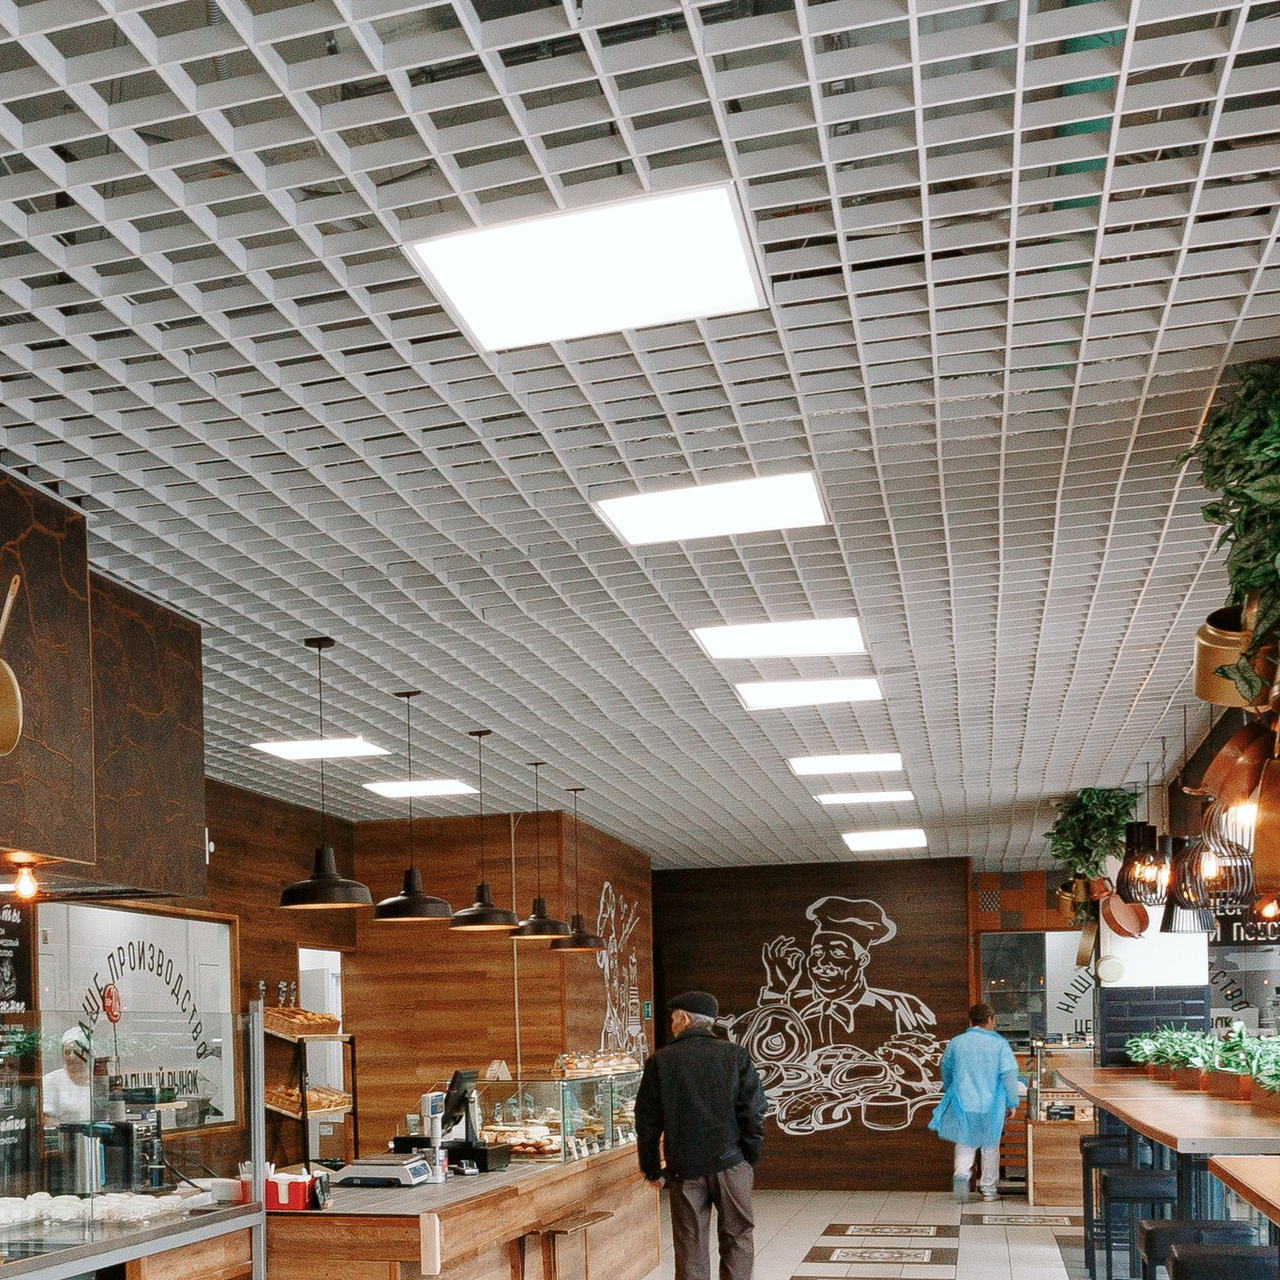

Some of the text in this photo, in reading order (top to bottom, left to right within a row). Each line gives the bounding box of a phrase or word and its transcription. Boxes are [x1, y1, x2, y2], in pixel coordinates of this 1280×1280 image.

[1233, 921, 1280, 941] ПОЕС
[107, 940, 208, 1060] ПРОИЗВОДСТВО
[167, 1069, 200, 1095] РЫНОК
